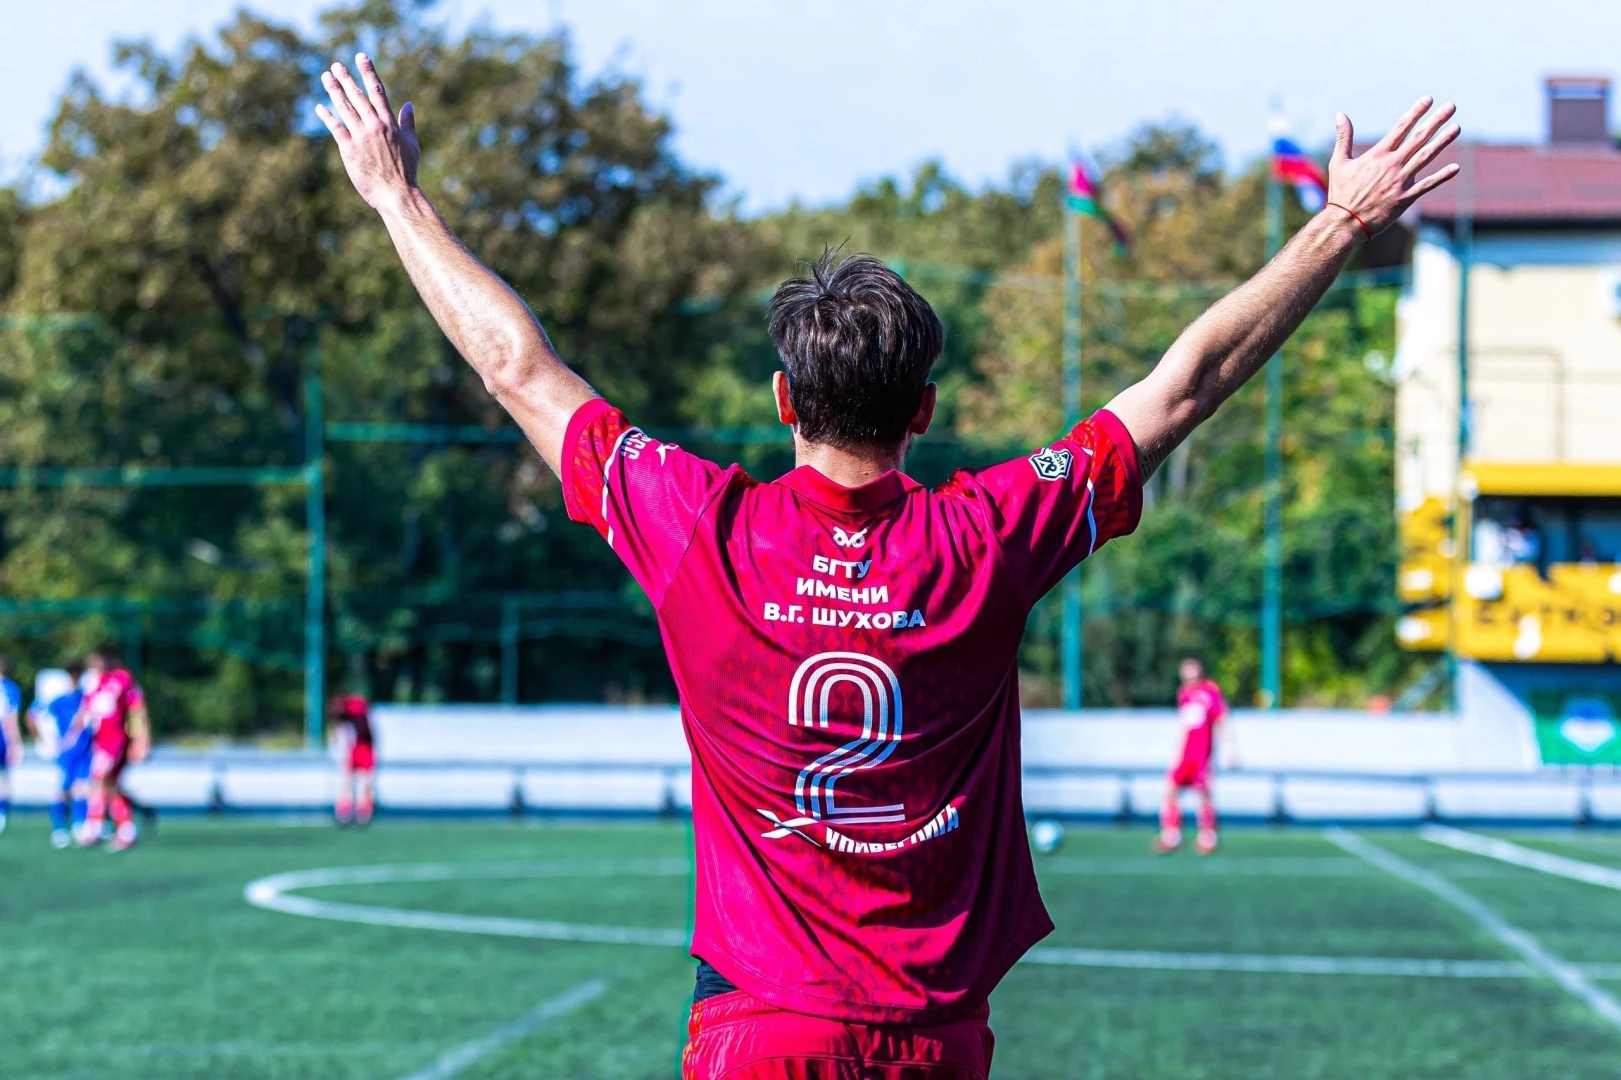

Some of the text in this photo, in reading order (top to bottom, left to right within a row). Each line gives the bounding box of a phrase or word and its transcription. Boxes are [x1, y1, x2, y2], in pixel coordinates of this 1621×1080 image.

[812, 554, 872, 578] БГТУ
[796, 577, 889, 604] ИМЕНИ
[763, 602, 926, 629] В.Г. ШУХОВА
[788, 651, 905, 824] 2
